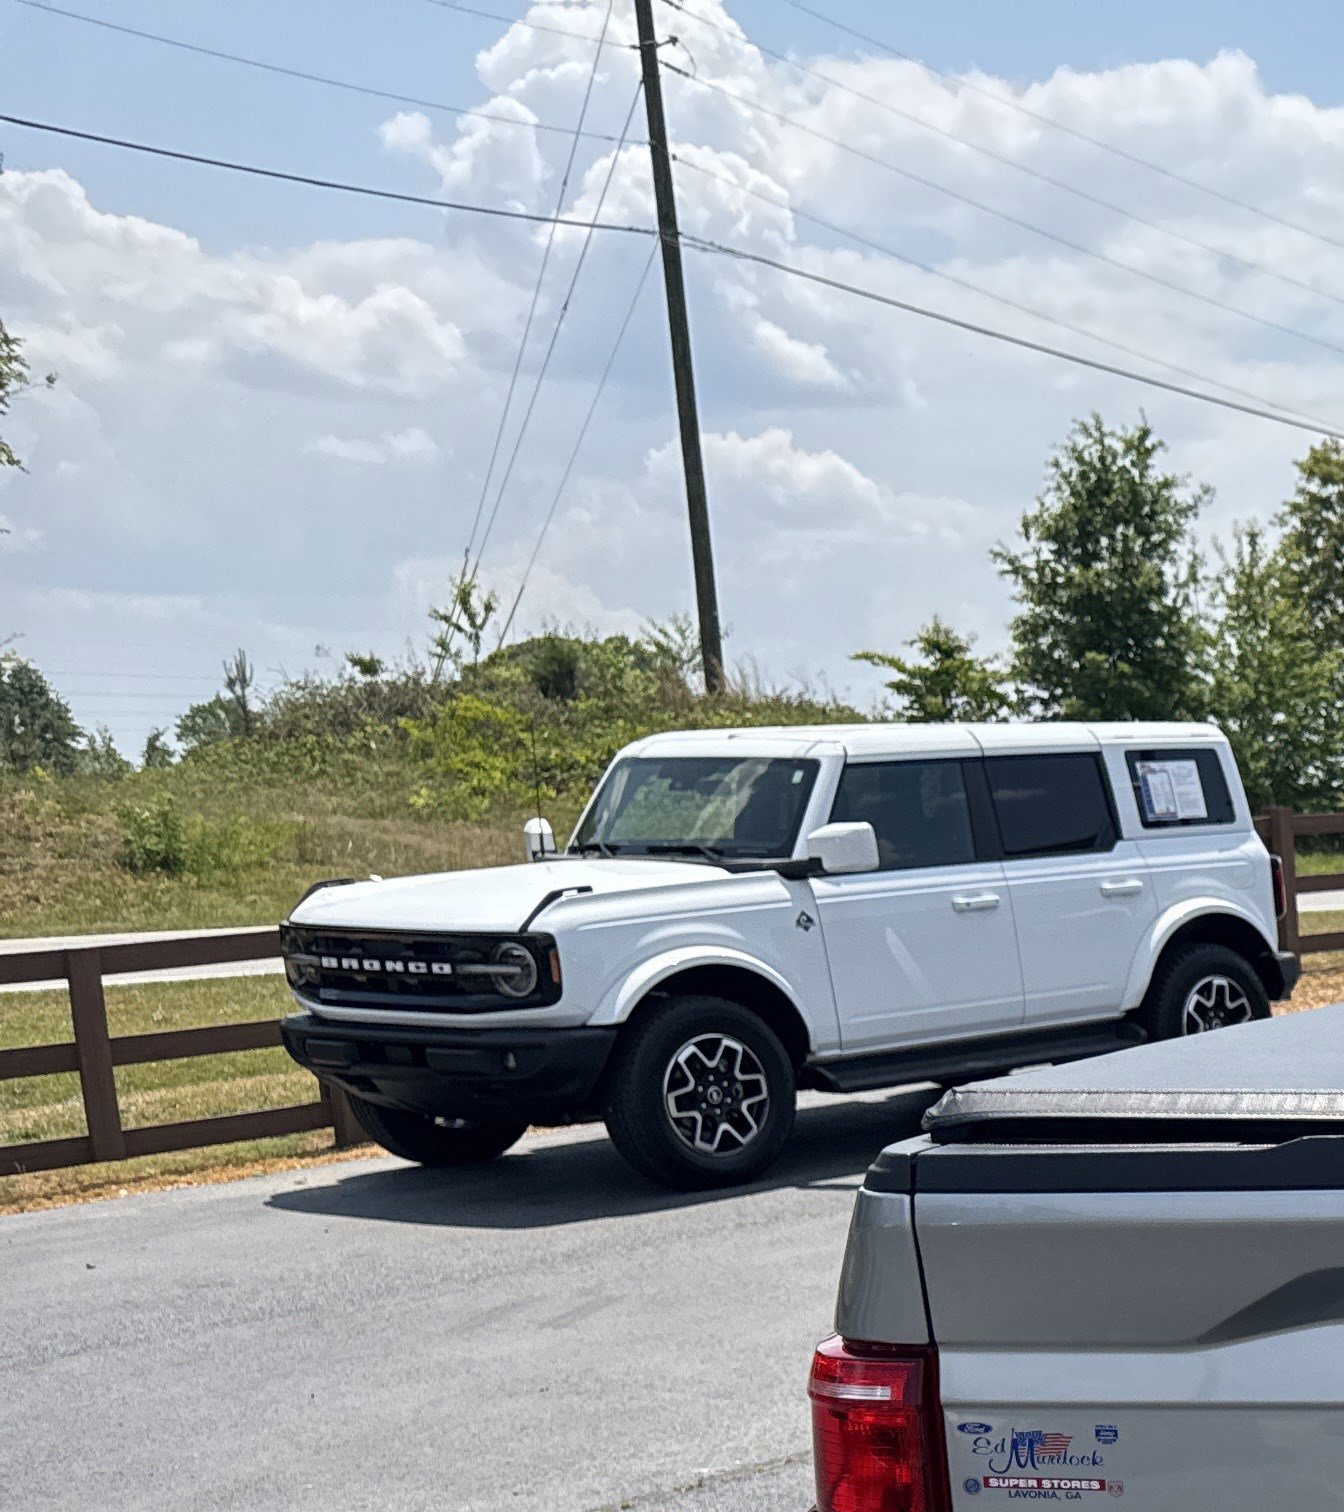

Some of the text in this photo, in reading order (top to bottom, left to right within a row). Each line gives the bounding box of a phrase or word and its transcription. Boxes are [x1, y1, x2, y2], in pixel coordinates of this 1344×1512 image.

[321, 956, 453, 974] BRONCO
[972, 1437, 1104, 1474] Ed Murdock
[988, 1478, 1038, 1488] SUPER
[1041, 1479, 1101, 1490] STORES
[1008, 1489, 1083, 1500] LAVONIA, GA
